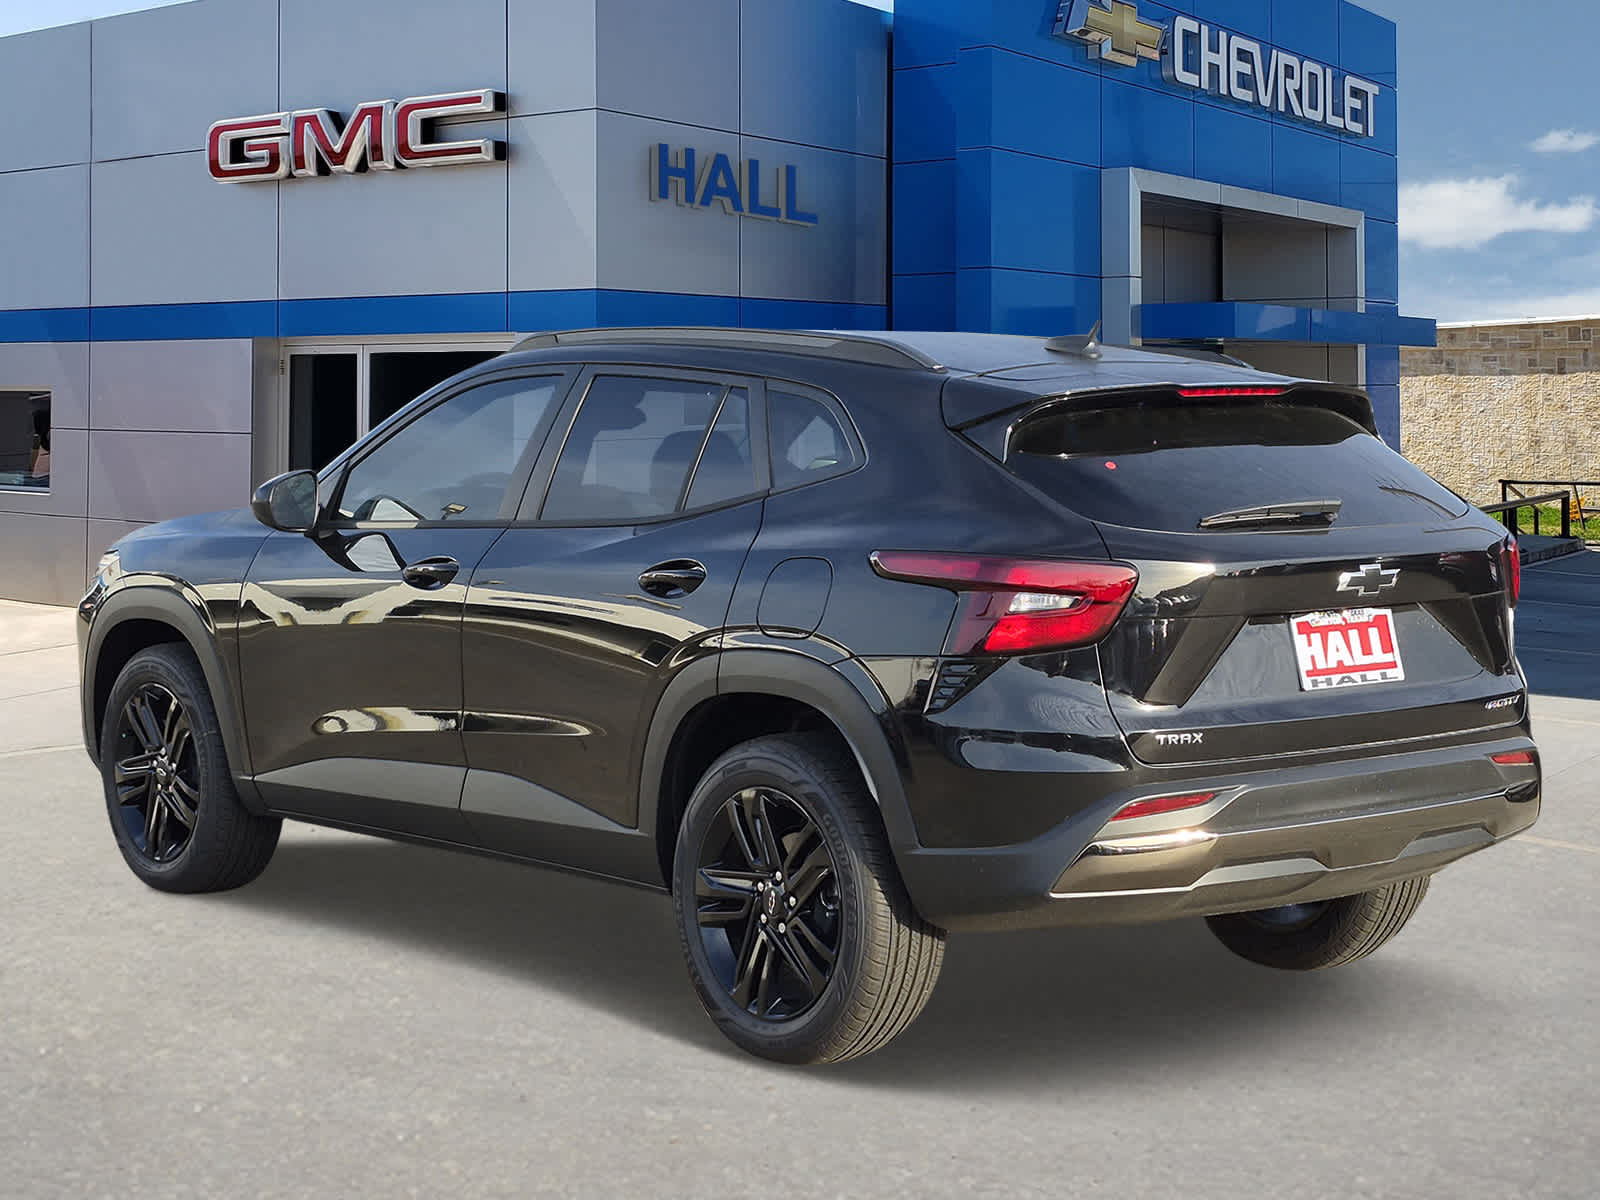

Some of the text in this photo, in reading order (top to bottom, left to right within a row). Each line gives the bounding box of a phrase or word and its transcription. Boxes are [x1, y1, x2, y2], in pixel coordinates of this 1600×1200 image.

[1172, 14, 1380, 138] CHEVROLET
[205, 88, 507, 184] GMC
[650, 142, 819, 228] HALL
[1297, 626, 1395, 671] HALL
[1310, 672, 1399, 688] HALL
[1154, 732, 1204, 745] TRAX
